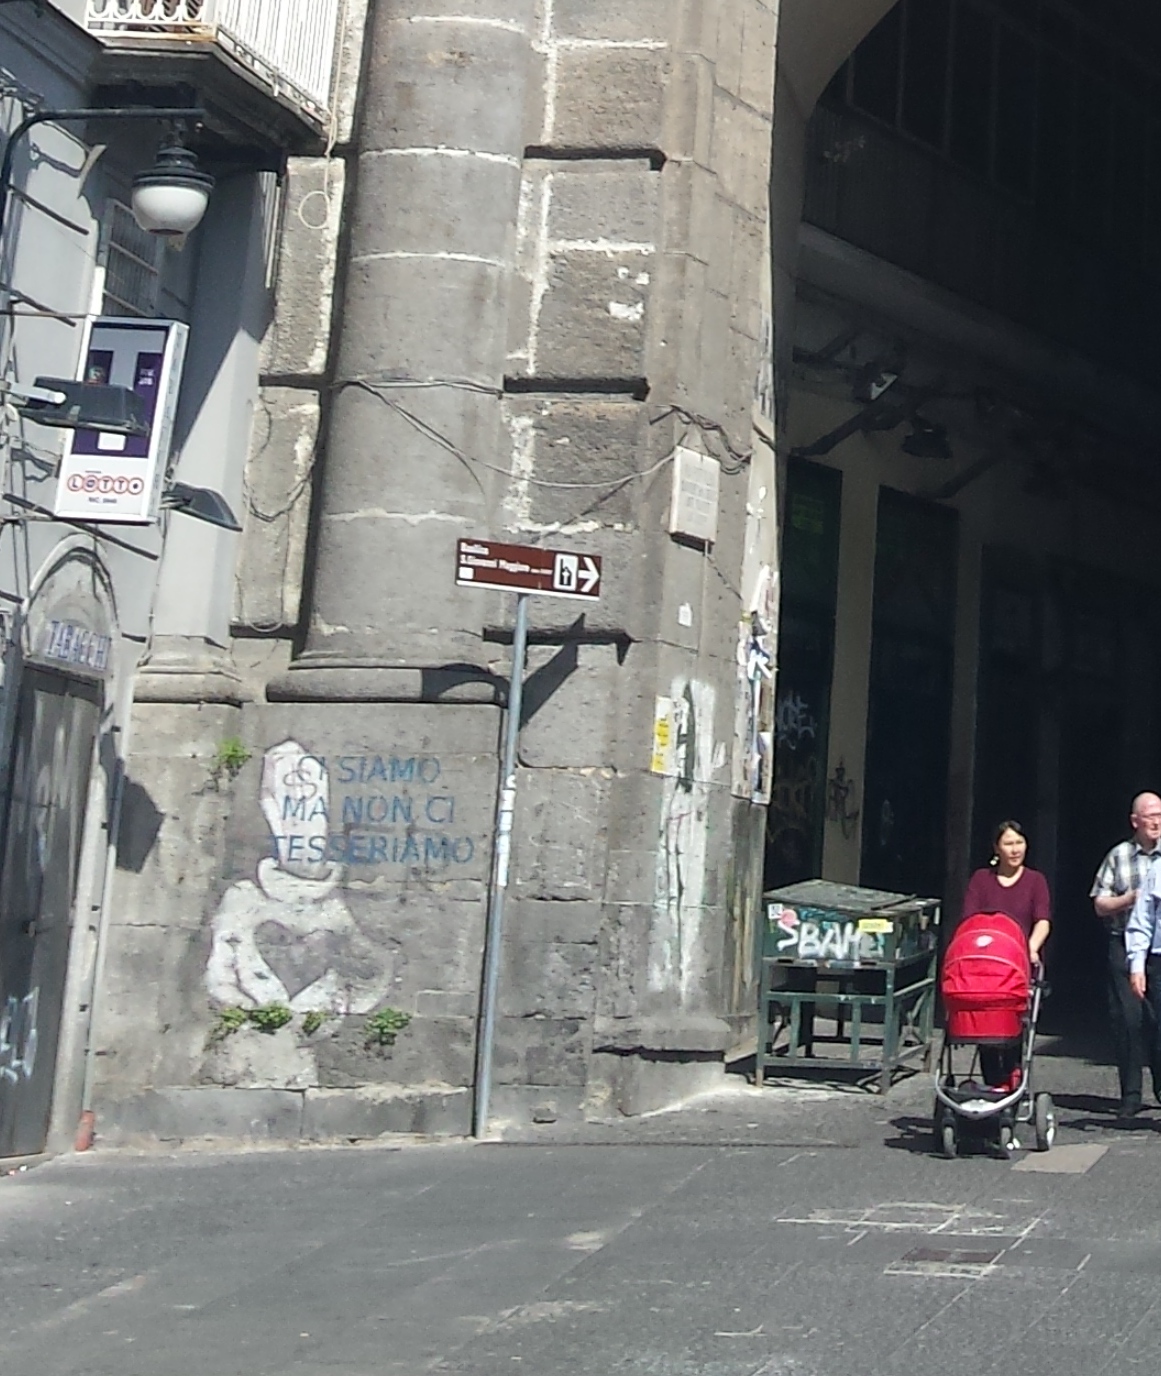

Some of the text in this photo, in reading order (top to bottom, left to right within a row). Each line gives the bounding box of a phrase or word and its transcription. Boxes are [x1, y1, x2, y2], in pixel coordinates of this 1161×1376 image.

[67, 473, 145, 495] LOTTO
[336, 755, 442, 783] SIAMO
[282, 795, 455, 824] MA NON CI
[267, 834, 475, 865] TESSERIAMO
